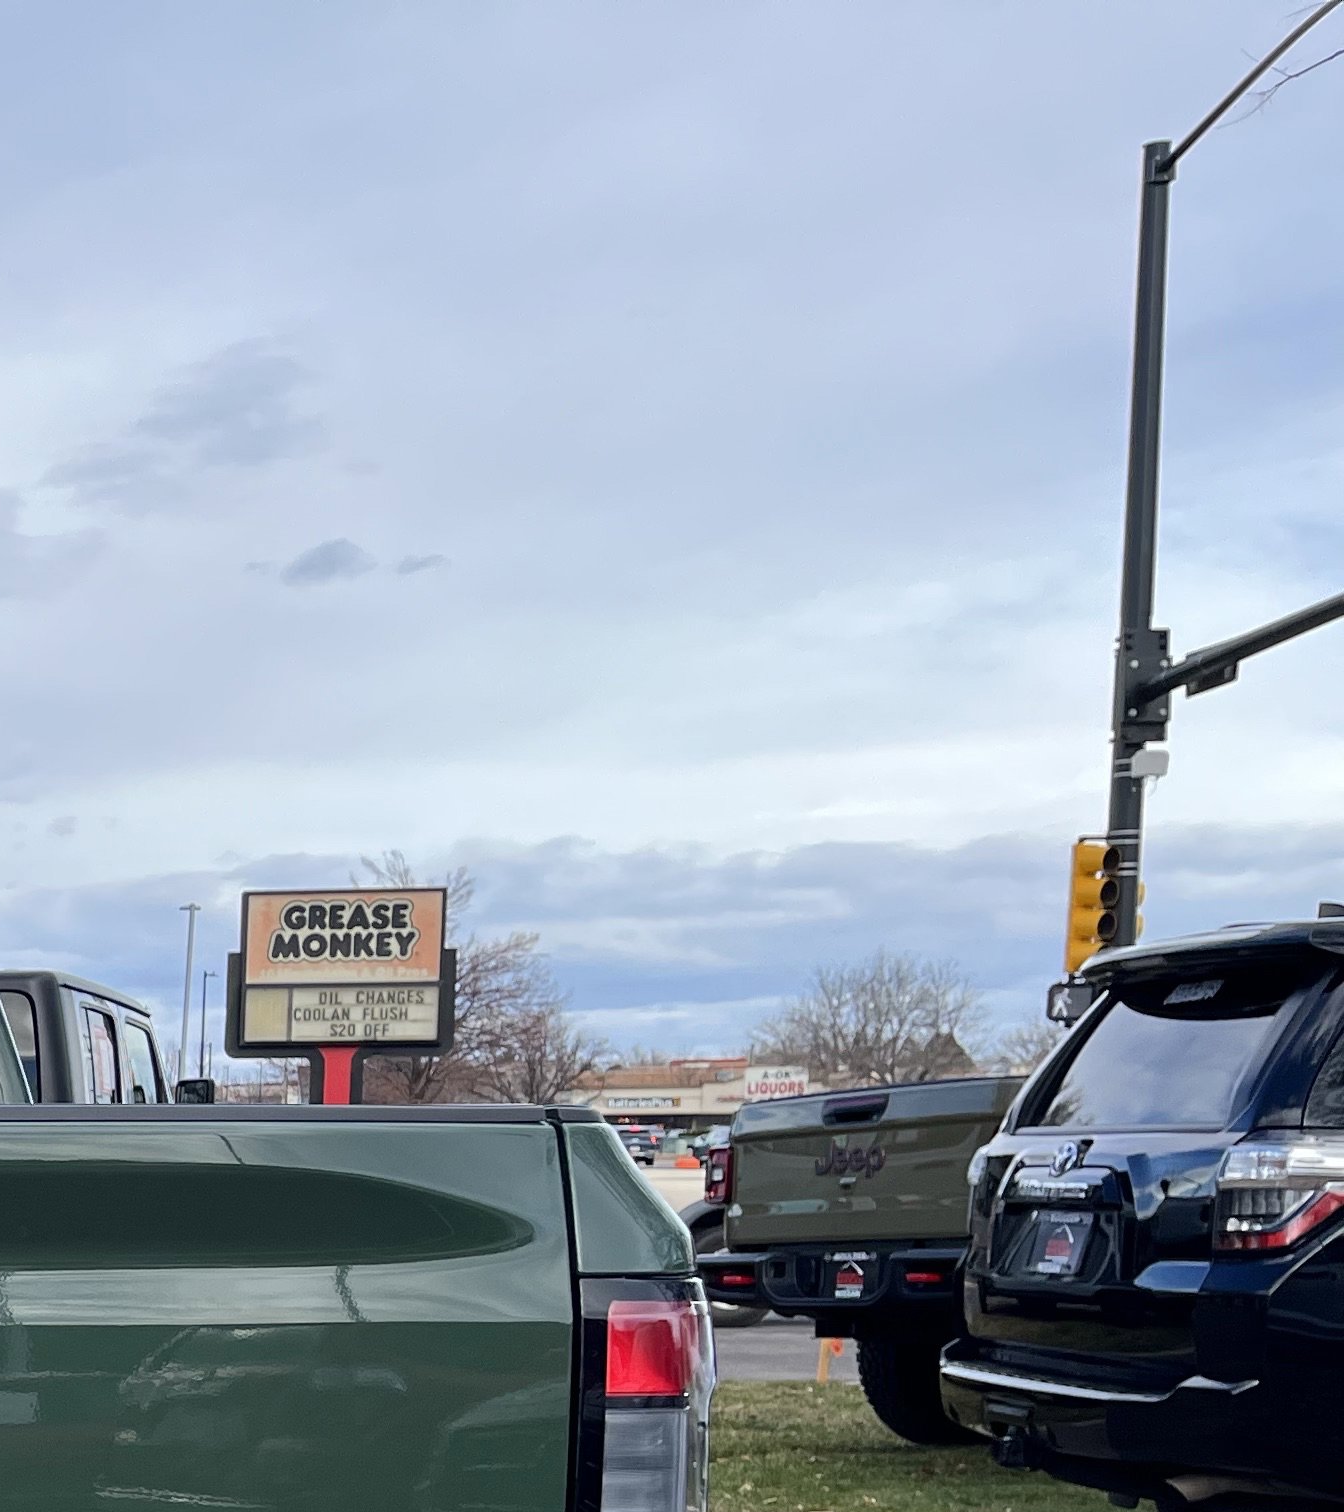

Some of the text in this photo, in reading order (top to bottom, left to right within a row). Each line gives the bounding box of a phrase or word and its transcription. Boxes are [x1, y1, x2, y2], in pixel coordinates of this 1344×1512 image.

[283, 903, 409, 930] GREASE
[271, 931, 416, 958] MONKEY
[319, 990, 425, 1005] OIL CHANGES
[293, 1007, 409, 1021] COOLAN FLUSH
[364, 1023, 389, 1038] OFF
[747, 1081, 805, 1095] LIQUORS
[815, 1139, 886, 1179] Jeep
